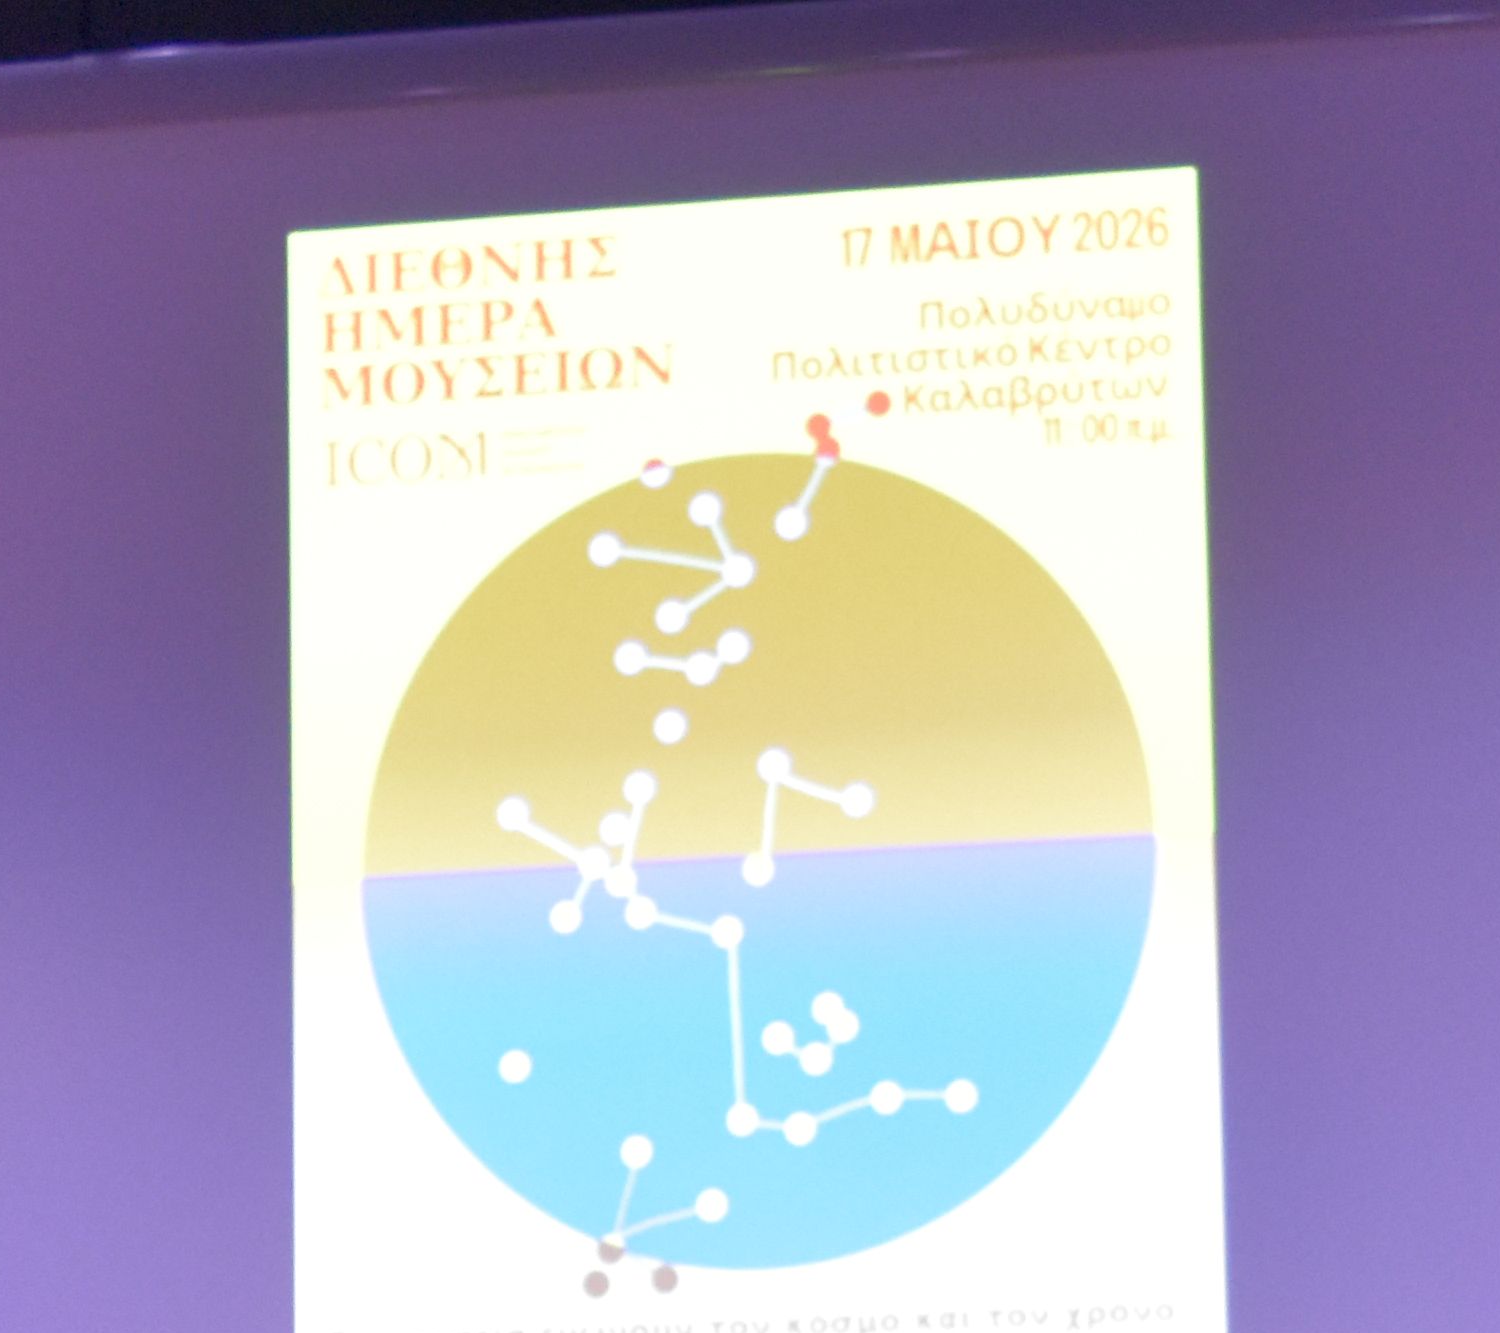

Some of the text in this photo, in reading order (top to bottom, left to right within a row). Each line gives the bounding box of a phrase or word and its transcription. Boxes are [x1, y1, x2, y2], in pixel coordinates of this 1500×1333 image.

[320, 234, 617, 297] ΔΙΕΘΝΗΣ
[842, 207, 1170, 267] 17 ΜΑΙΟΥ 2026
[323, 297, 558, 354] ΗΜΕΡΑ
[322, 342, 676, 410] ΜΟΥΣΕΙΩΝ
